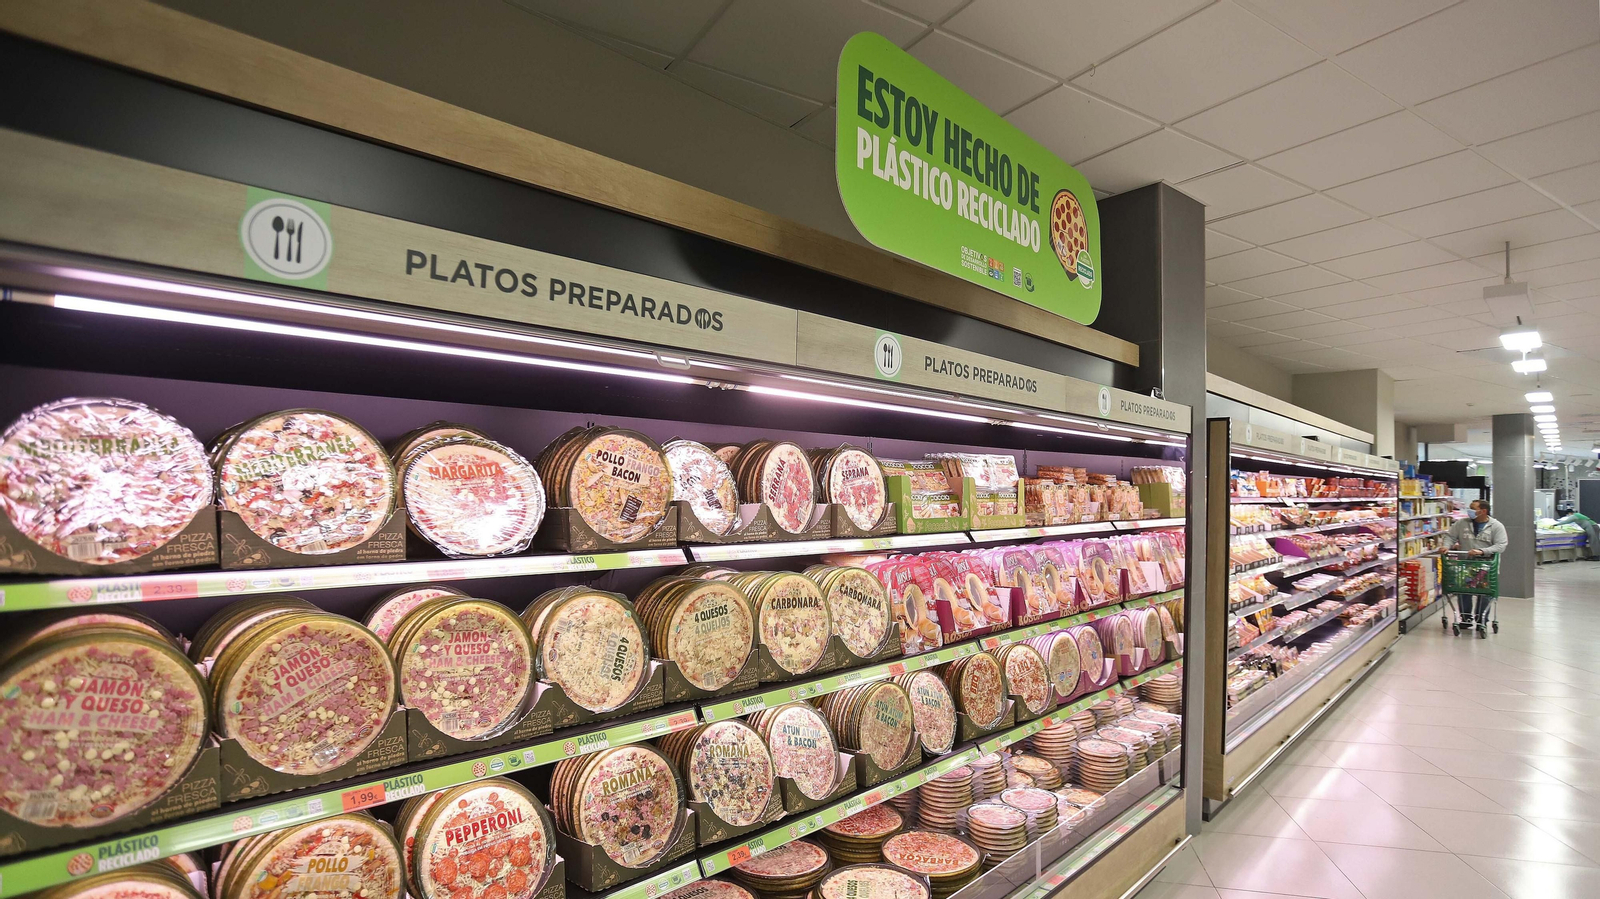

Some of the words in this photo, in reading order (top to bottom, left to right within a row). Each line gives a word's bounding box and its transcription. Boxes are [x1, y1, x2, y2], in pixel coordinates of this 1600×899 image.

[857, 64, 938, 155] ESTOY
[944, 117, 1012, 198] HECHO
[1017, 163, 1040, 214] DE
[857, 126, 951, 211] PLÁSTICO
[957, 179, 1040, 253] RECICLADO
[961, 260, 987, 275] SOSTENIBLE
[406, 249, 537, 298] PLATOS
[549, 277, 724, 332] PREPARADOS
[925, 355, 969, 380] PLATOS
[973, 366, 1037, 393] PREPARADOS
[1120, 400, 1142, 415] PLATOS
[1143, 404, 1176, 421] PREPARADOS
[428, 461, 504, 480] MARGARITA
[596, 449, 625, 466] POLLO
[626, 459, 660, 477] FRANGO
[612, 467, 641, 483] BACON
[768, 457, 787, 502] SERRANA
[841, 466, 869, 480] SERRANA
[180, 532, 214, 542] PIZZA
[378, 532, 403, 540] PIZZA
[166, 542, 214, 553] FRESCA
[771, 597, 819, 610] CARBONARA
[840, 583, 881, 611] CARBONARA
[695, 612, 700, 623] 4
[700, 604, 728, 620] QUESOS
[695, 626, 700, 635] 4
[701, 616, 730, 634] QUEIJOS
[448, 627, 487, 644] JAMÓN
[620, 636, 629, 644] 4
[444, 644, 451, 656] Y
[454, 643, 491, 656] QUESO
[272, 646, 321, 681] JAMÓN
[429, 657, 453, 668] HAM
[456, 656, 463, 667] &
[466, 654, 501, 666] CHEESE
[611, 644, 628, 681] QUESOS
[272, 683, 284, 695] Y
[286, 656, 331, 688] QUESO
[74, 676, 144, 697] JAMÓN
[263, 690, 297, 718] HAM
[299, 686, 306, 697] &
[307, 659, 350, 691] CHEESE
[646, 684, 662, 692] PIZZA
[970, 675, 980, 694] BBQ
[640, 690, 663, 700] FRESCA
[742, 696, 764, 707] PLÁSTICO
[64, 694, 78, 710] Y
[81, 695, 144, 714] QUESO
[875, 700, 888, 711] ATUN
[889, 705, 904, 720] ATUM
[29, 712, 75, 726] HAM
[79, 713, 90, 727] &
[97, 715, 159, 730] CHEESE
[522, 717, 552, 728] FRESCA
[530, 710, 552, 719] PIZZA
[881, 715, 898, 729] BACON
[577, 732, 607, 746] PLÁSTICO
[783, 725, 800, 735] ATUN
[801, 727, 821, 739] ATUM
[378, 735, 404, 748] PIZZA
[579, 740, 610, 754] RECICLADO
[788, 737, 792, 745] &
[794, 737, 817, 748] BACON
[367, 745, 405, 758] FRESCA
[709, 744, 749, 758] ROMANA
[182, 777, 216, 792] PIZZA
[384, 774, 423, 791] PLÁSTICO
[602, 766, 653, 796] ROMANA
[167, 787, 217, 806] FRESCA
[386, 783, 426, 801] RECICLADO
[844, 798, 862, 810] PLÁSTICO
[445, 807, 524, 847] PEPPERONI
[99, 834, 159, 858] PLÁSTICO
[98, 847, 160, 872] RECICLADO
[307, 857, 348, 873] POLLO
[899, 854, 959, 866] BARBACOA
[297, 875, 351, 890] FRANGO
[543, 884, 563, 895] PIZZA
